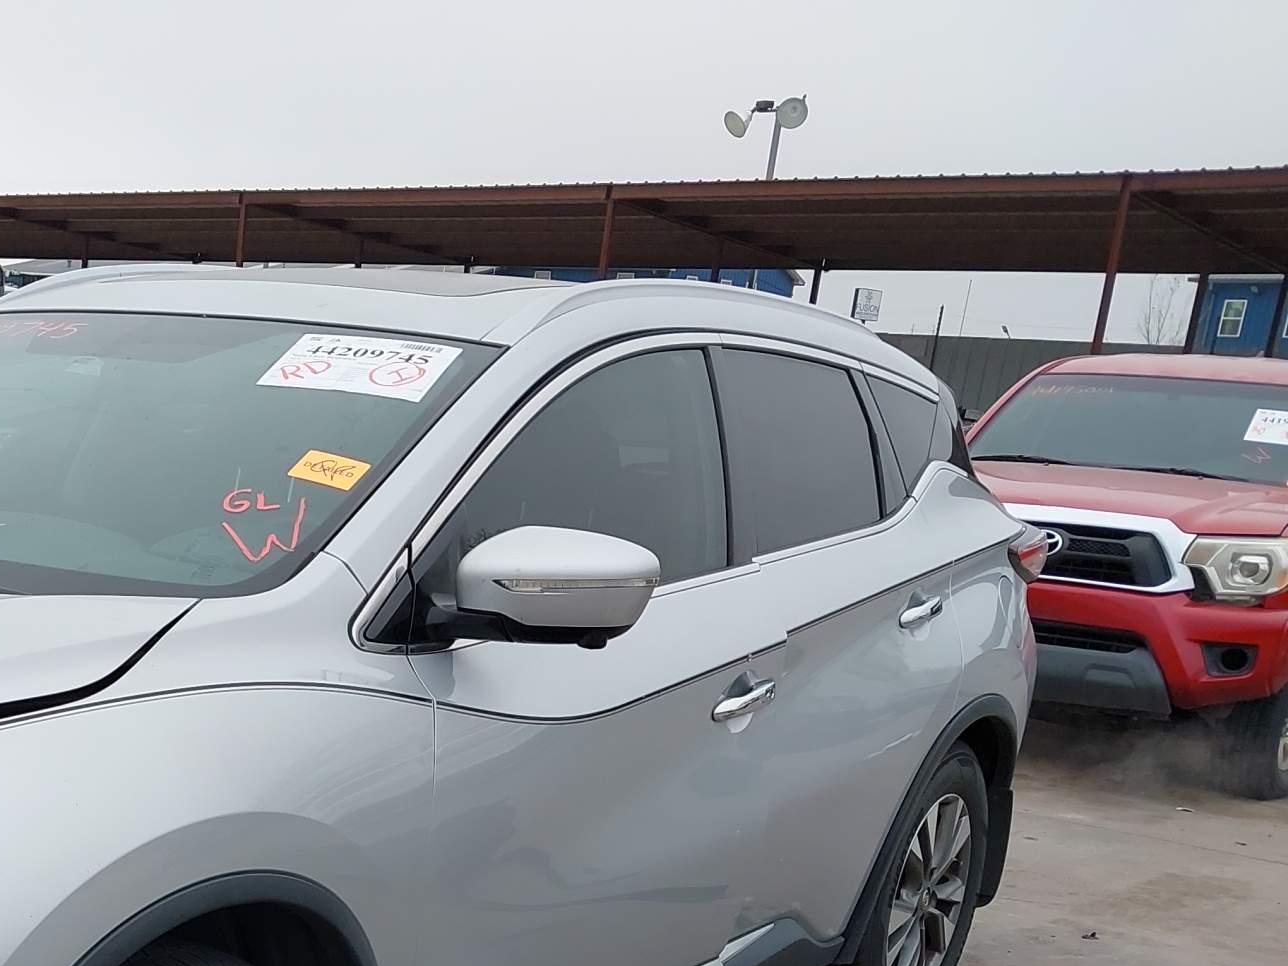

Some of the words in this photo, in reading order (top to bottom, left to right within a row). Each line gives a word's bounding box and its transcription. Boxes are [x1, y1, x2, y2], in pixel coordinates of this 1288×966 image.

[306, 345, 433, 365] 44209745
[280, 360, 332, 380] RD
[222, 488, 281, 513] GL
[222, 497, 306, 562] W
